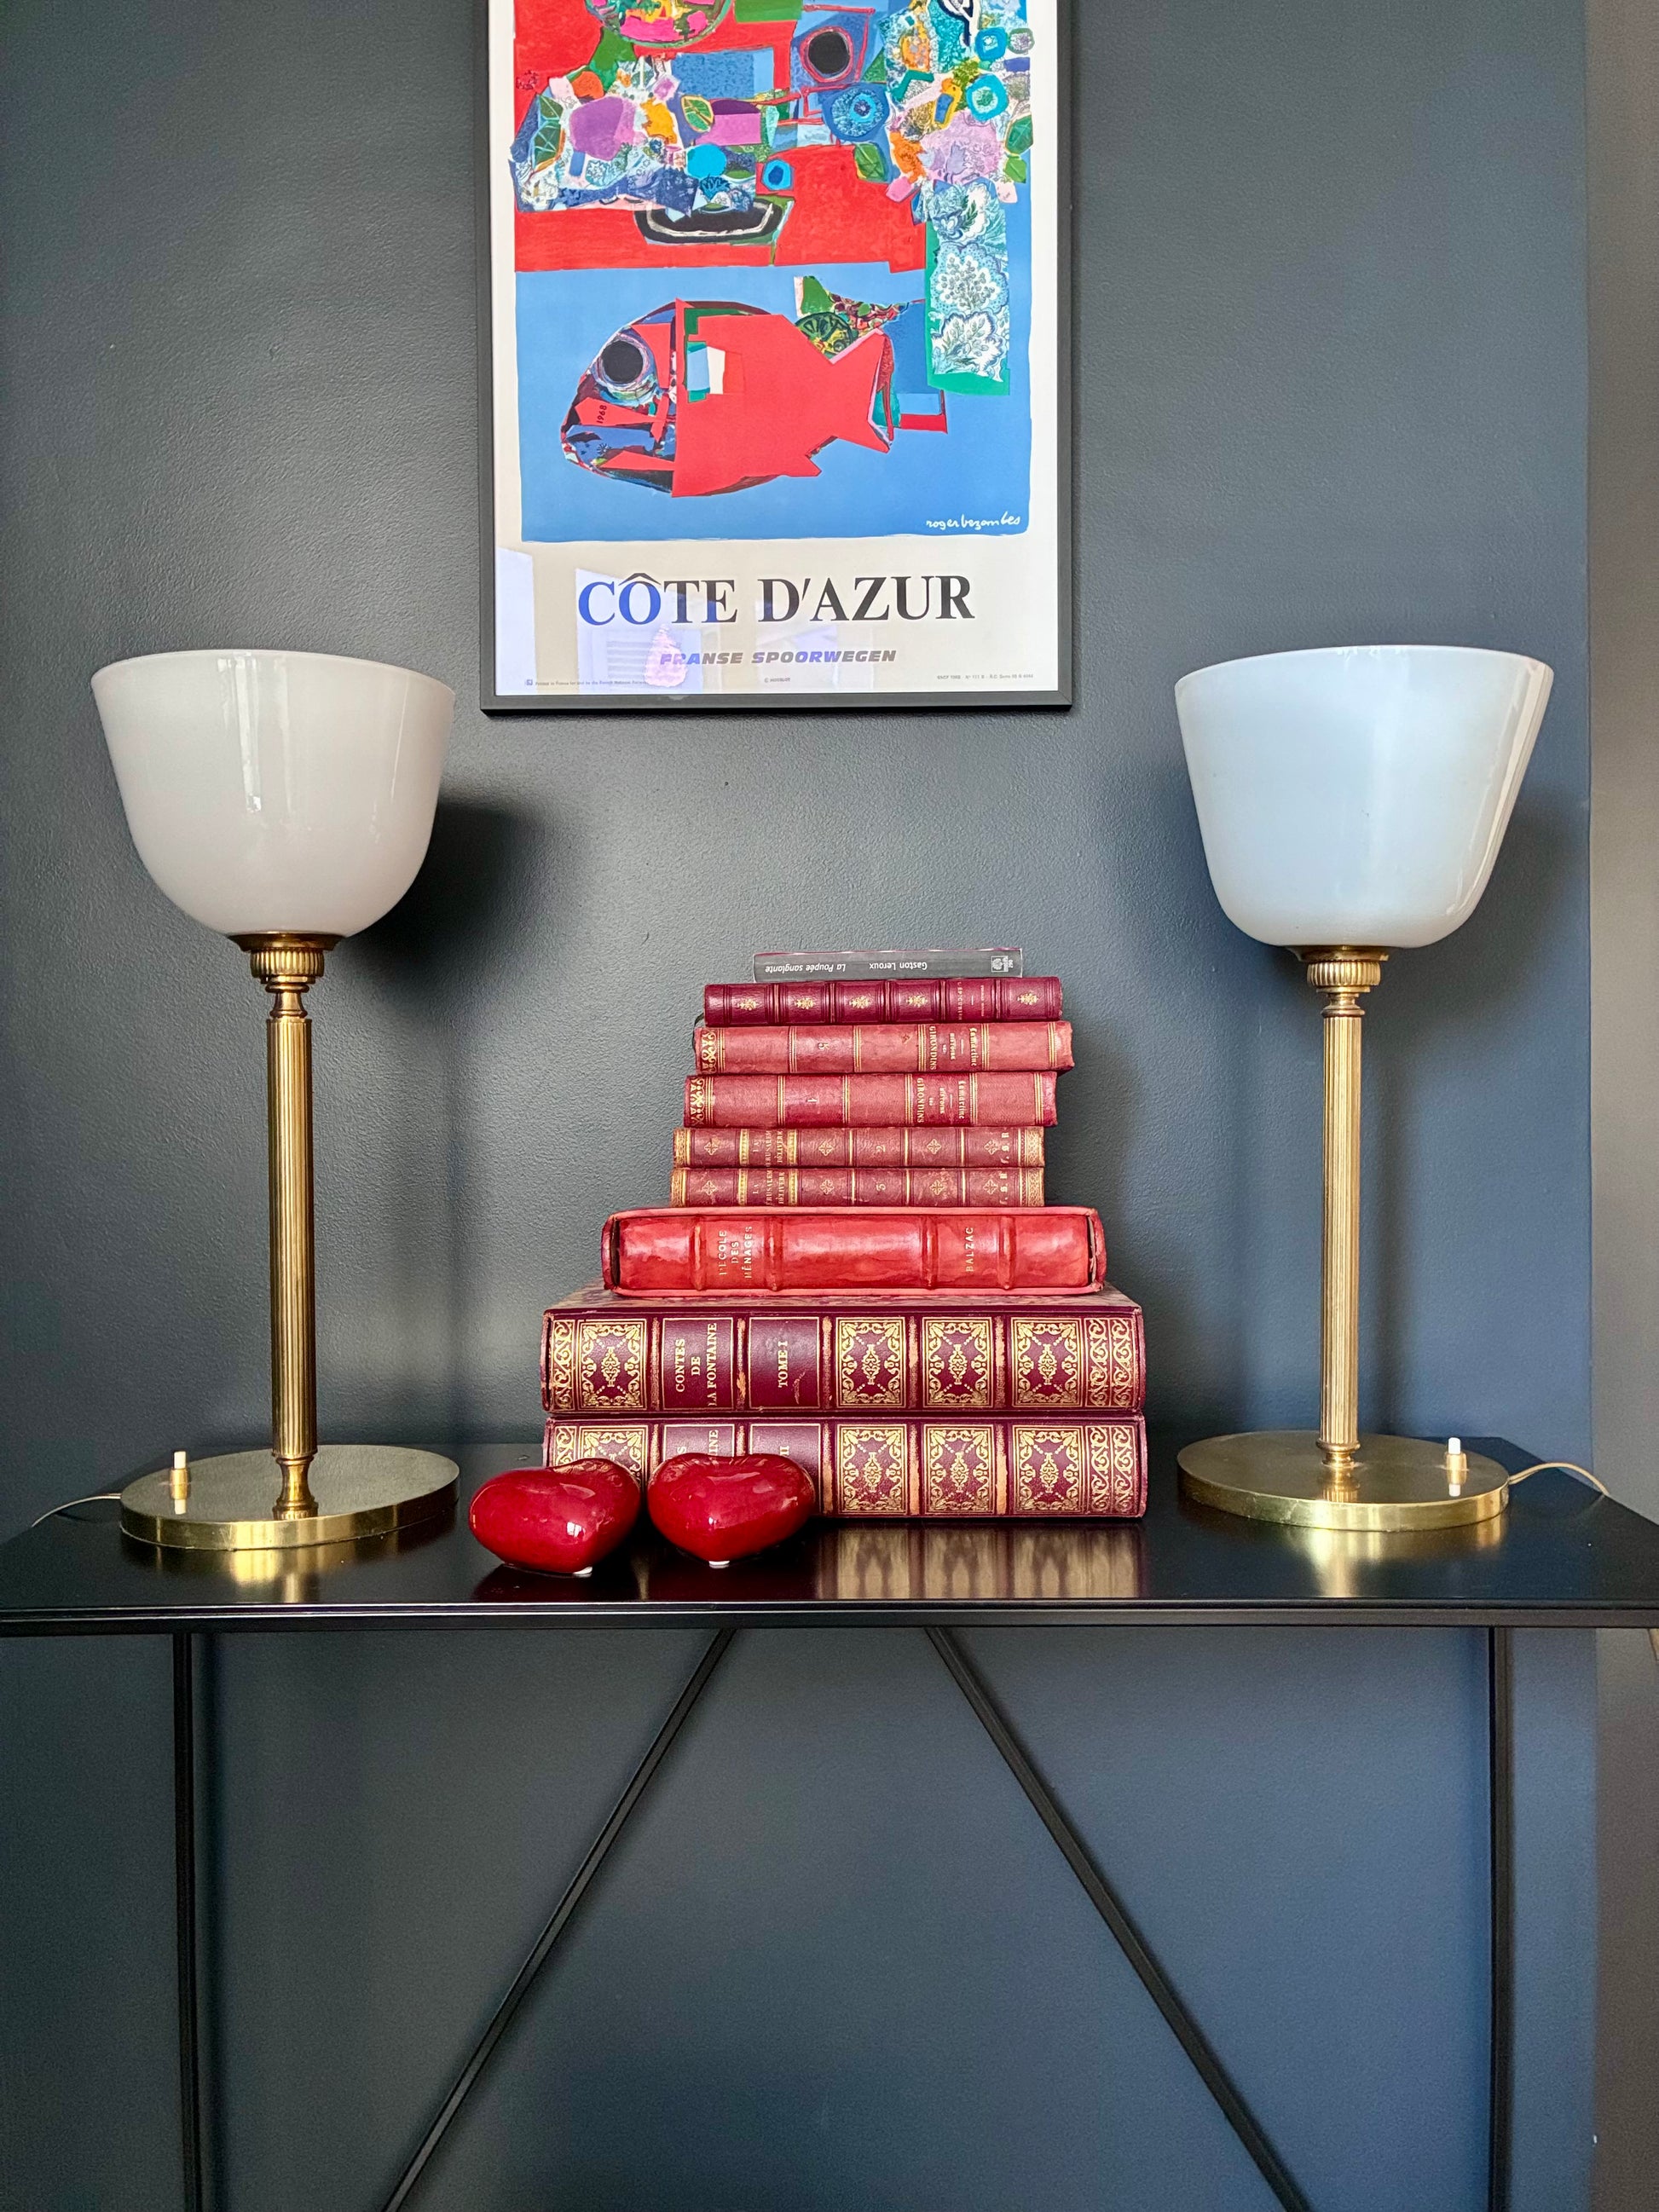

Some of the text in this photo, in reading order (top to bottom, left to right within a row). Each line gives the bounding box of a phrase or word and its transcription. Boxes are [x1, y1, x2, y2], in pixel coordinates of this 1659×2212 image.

[596, 404, 608, 424] 1968
[577, 572, 976, 626] CÔTE D'AZUR
[660, 650, 897, 665] FRANSE SPOORWEGEN
[765, 962, 847, 974] La Poupée sanglante
[869, 961, 928, 971] Gaston Leroux
[731, 1241, 739, 1264] DES
[741, 1226, 753, 1279] MÉNAGES
[965, 1227, 974, 1273] BALZAC
[675, 1338, 685, 1393] CONTES
[691, 1356, 701, 1377] DE
[706, 1322, 717, 1406] LA FONTAINE
[777, 1349, 789, 1389] TOME
